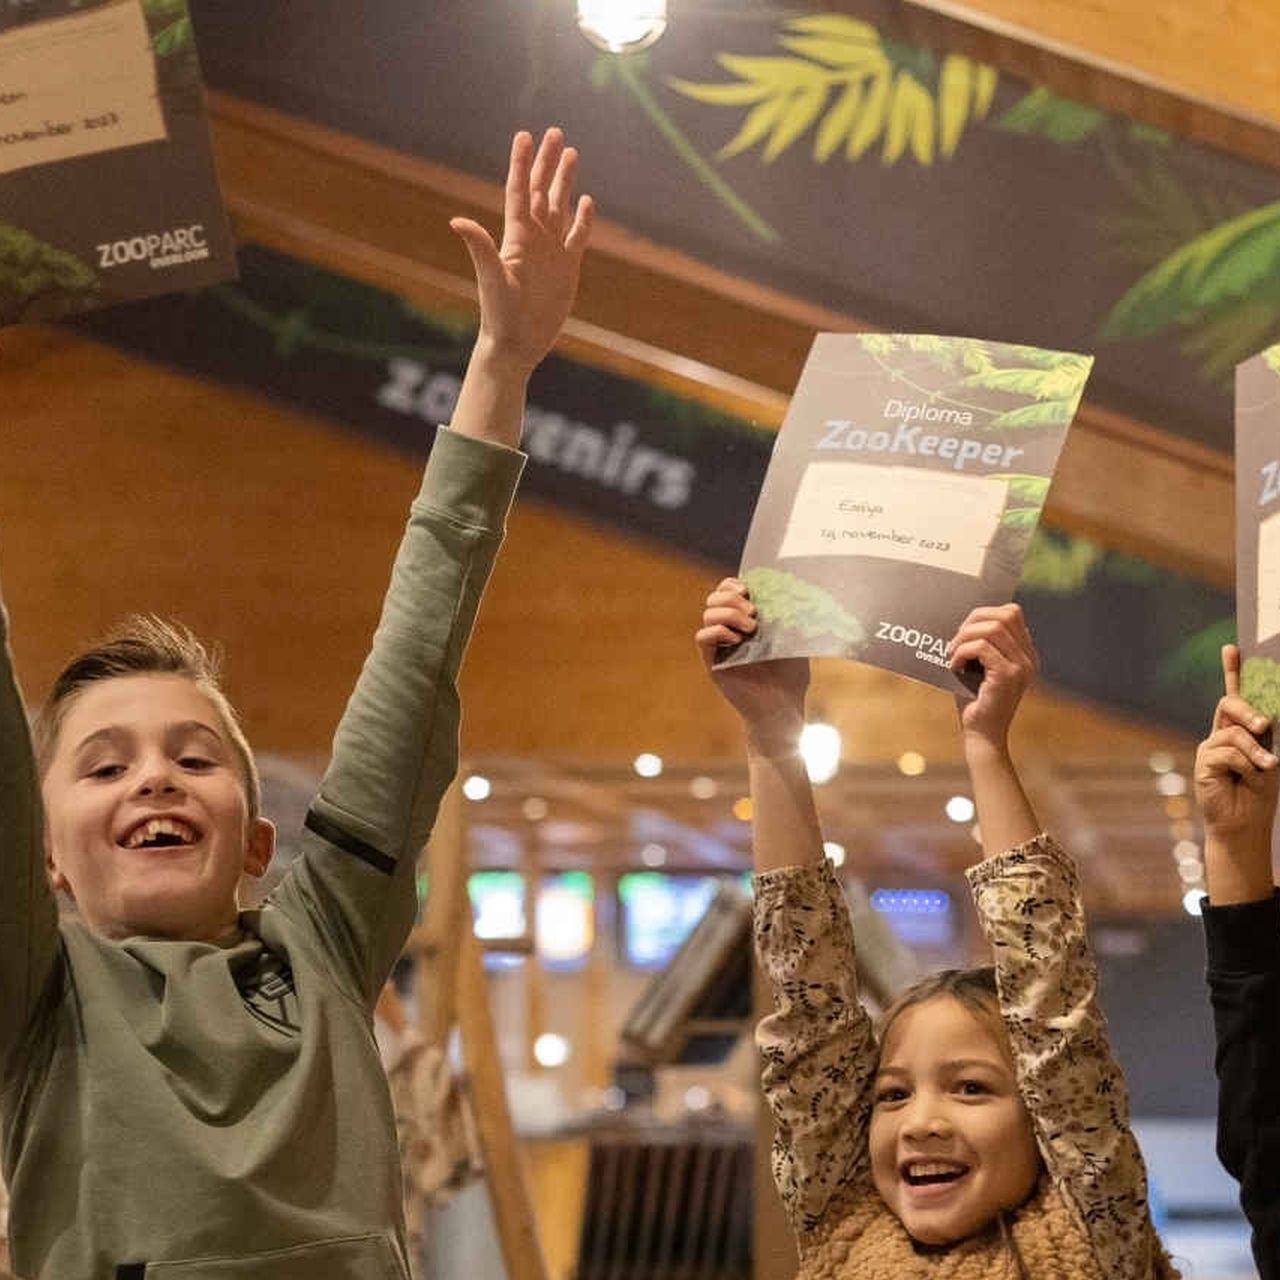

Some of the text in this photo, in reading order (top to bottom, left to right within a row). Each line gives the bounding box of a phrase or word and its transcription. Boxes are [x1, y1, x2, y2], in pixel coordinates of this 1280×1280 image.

[96, 224, 207, 268] ZOOPARC
[883, 399, 974, 427] Diploma
[376, 356, 698, 512] zoenirs
[815, 419, 1025, 470] ZooKeeper
[842, 529, 915, 545] november
[875, 621, 953, 658] ZOOPA
[915, 650, 954, 670] OVERLO
